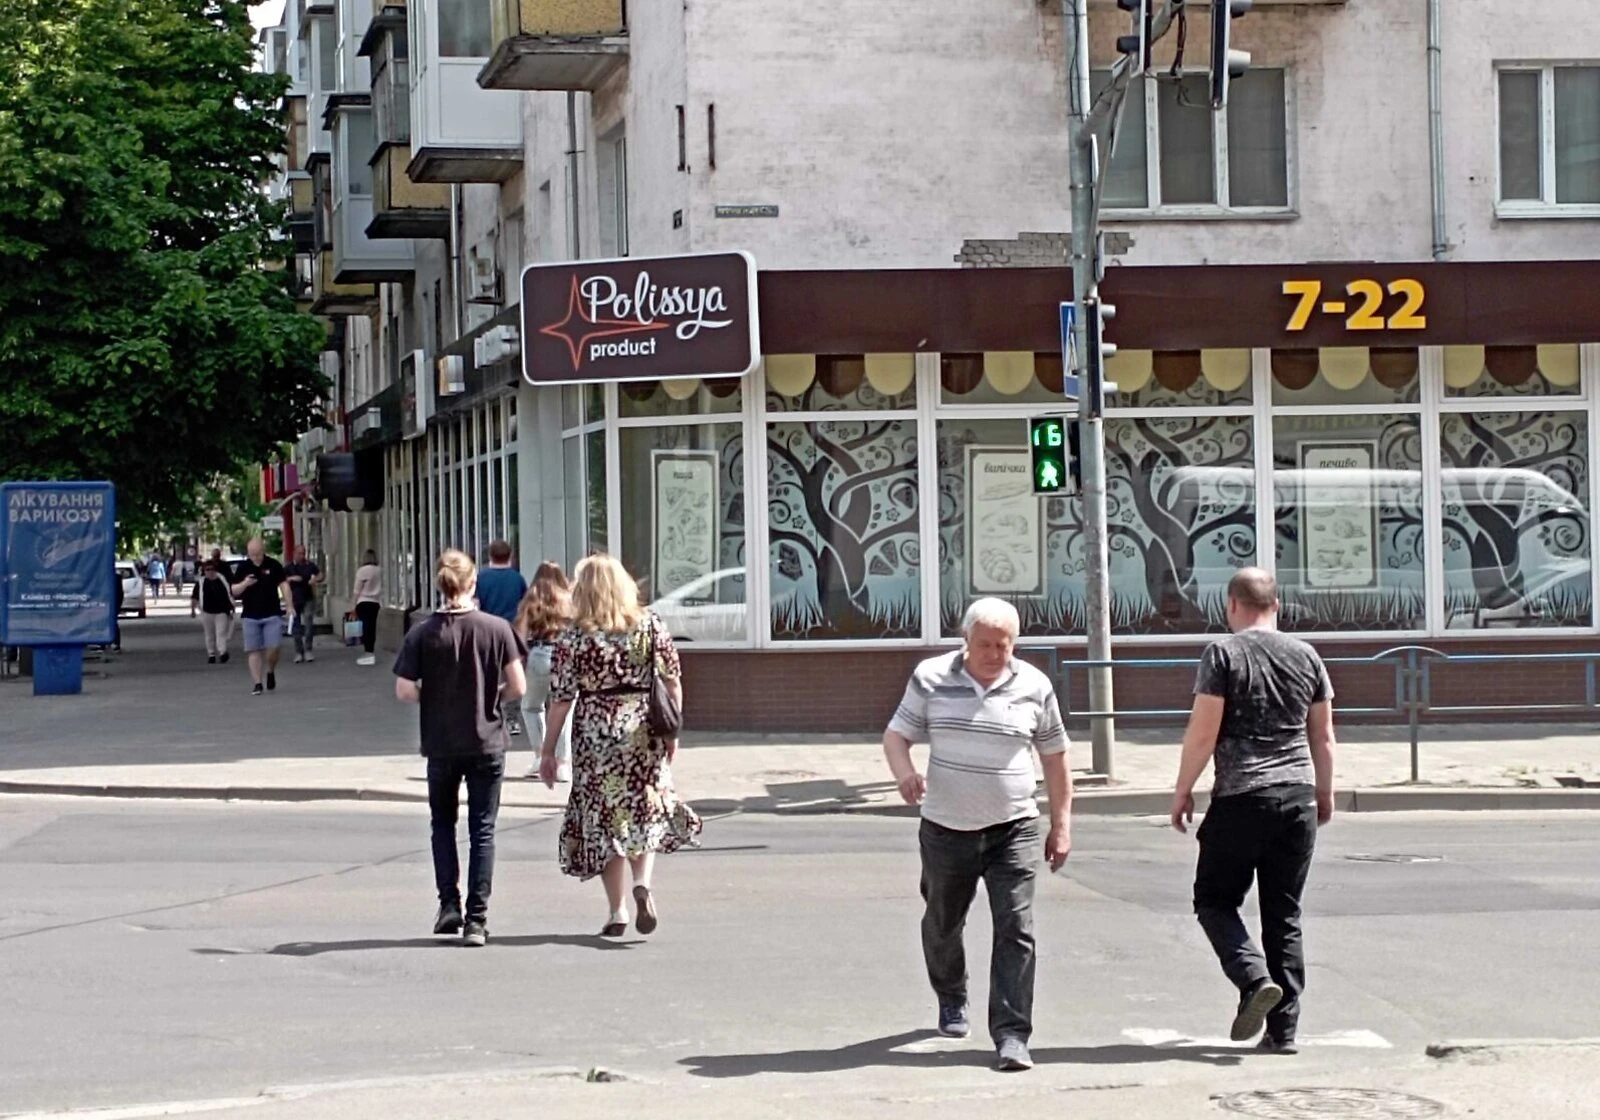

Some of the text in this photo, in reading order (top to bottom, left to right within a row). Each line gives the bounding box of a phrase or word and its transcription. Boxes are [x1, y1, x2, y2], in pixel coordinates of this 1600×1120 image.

[581, 271, 733, 340] Polissya
[1282, 278, 1427, 331] 7-22
[590, 337, 656, 361] product
[984, 461, 1026, 473] випічка
[1319, 457, 1358, 469] печиво
[10, 492, 104, 507] ЛІКУВАННЯ
[9, 508, 102, 522] ВАРИКОЗУ
